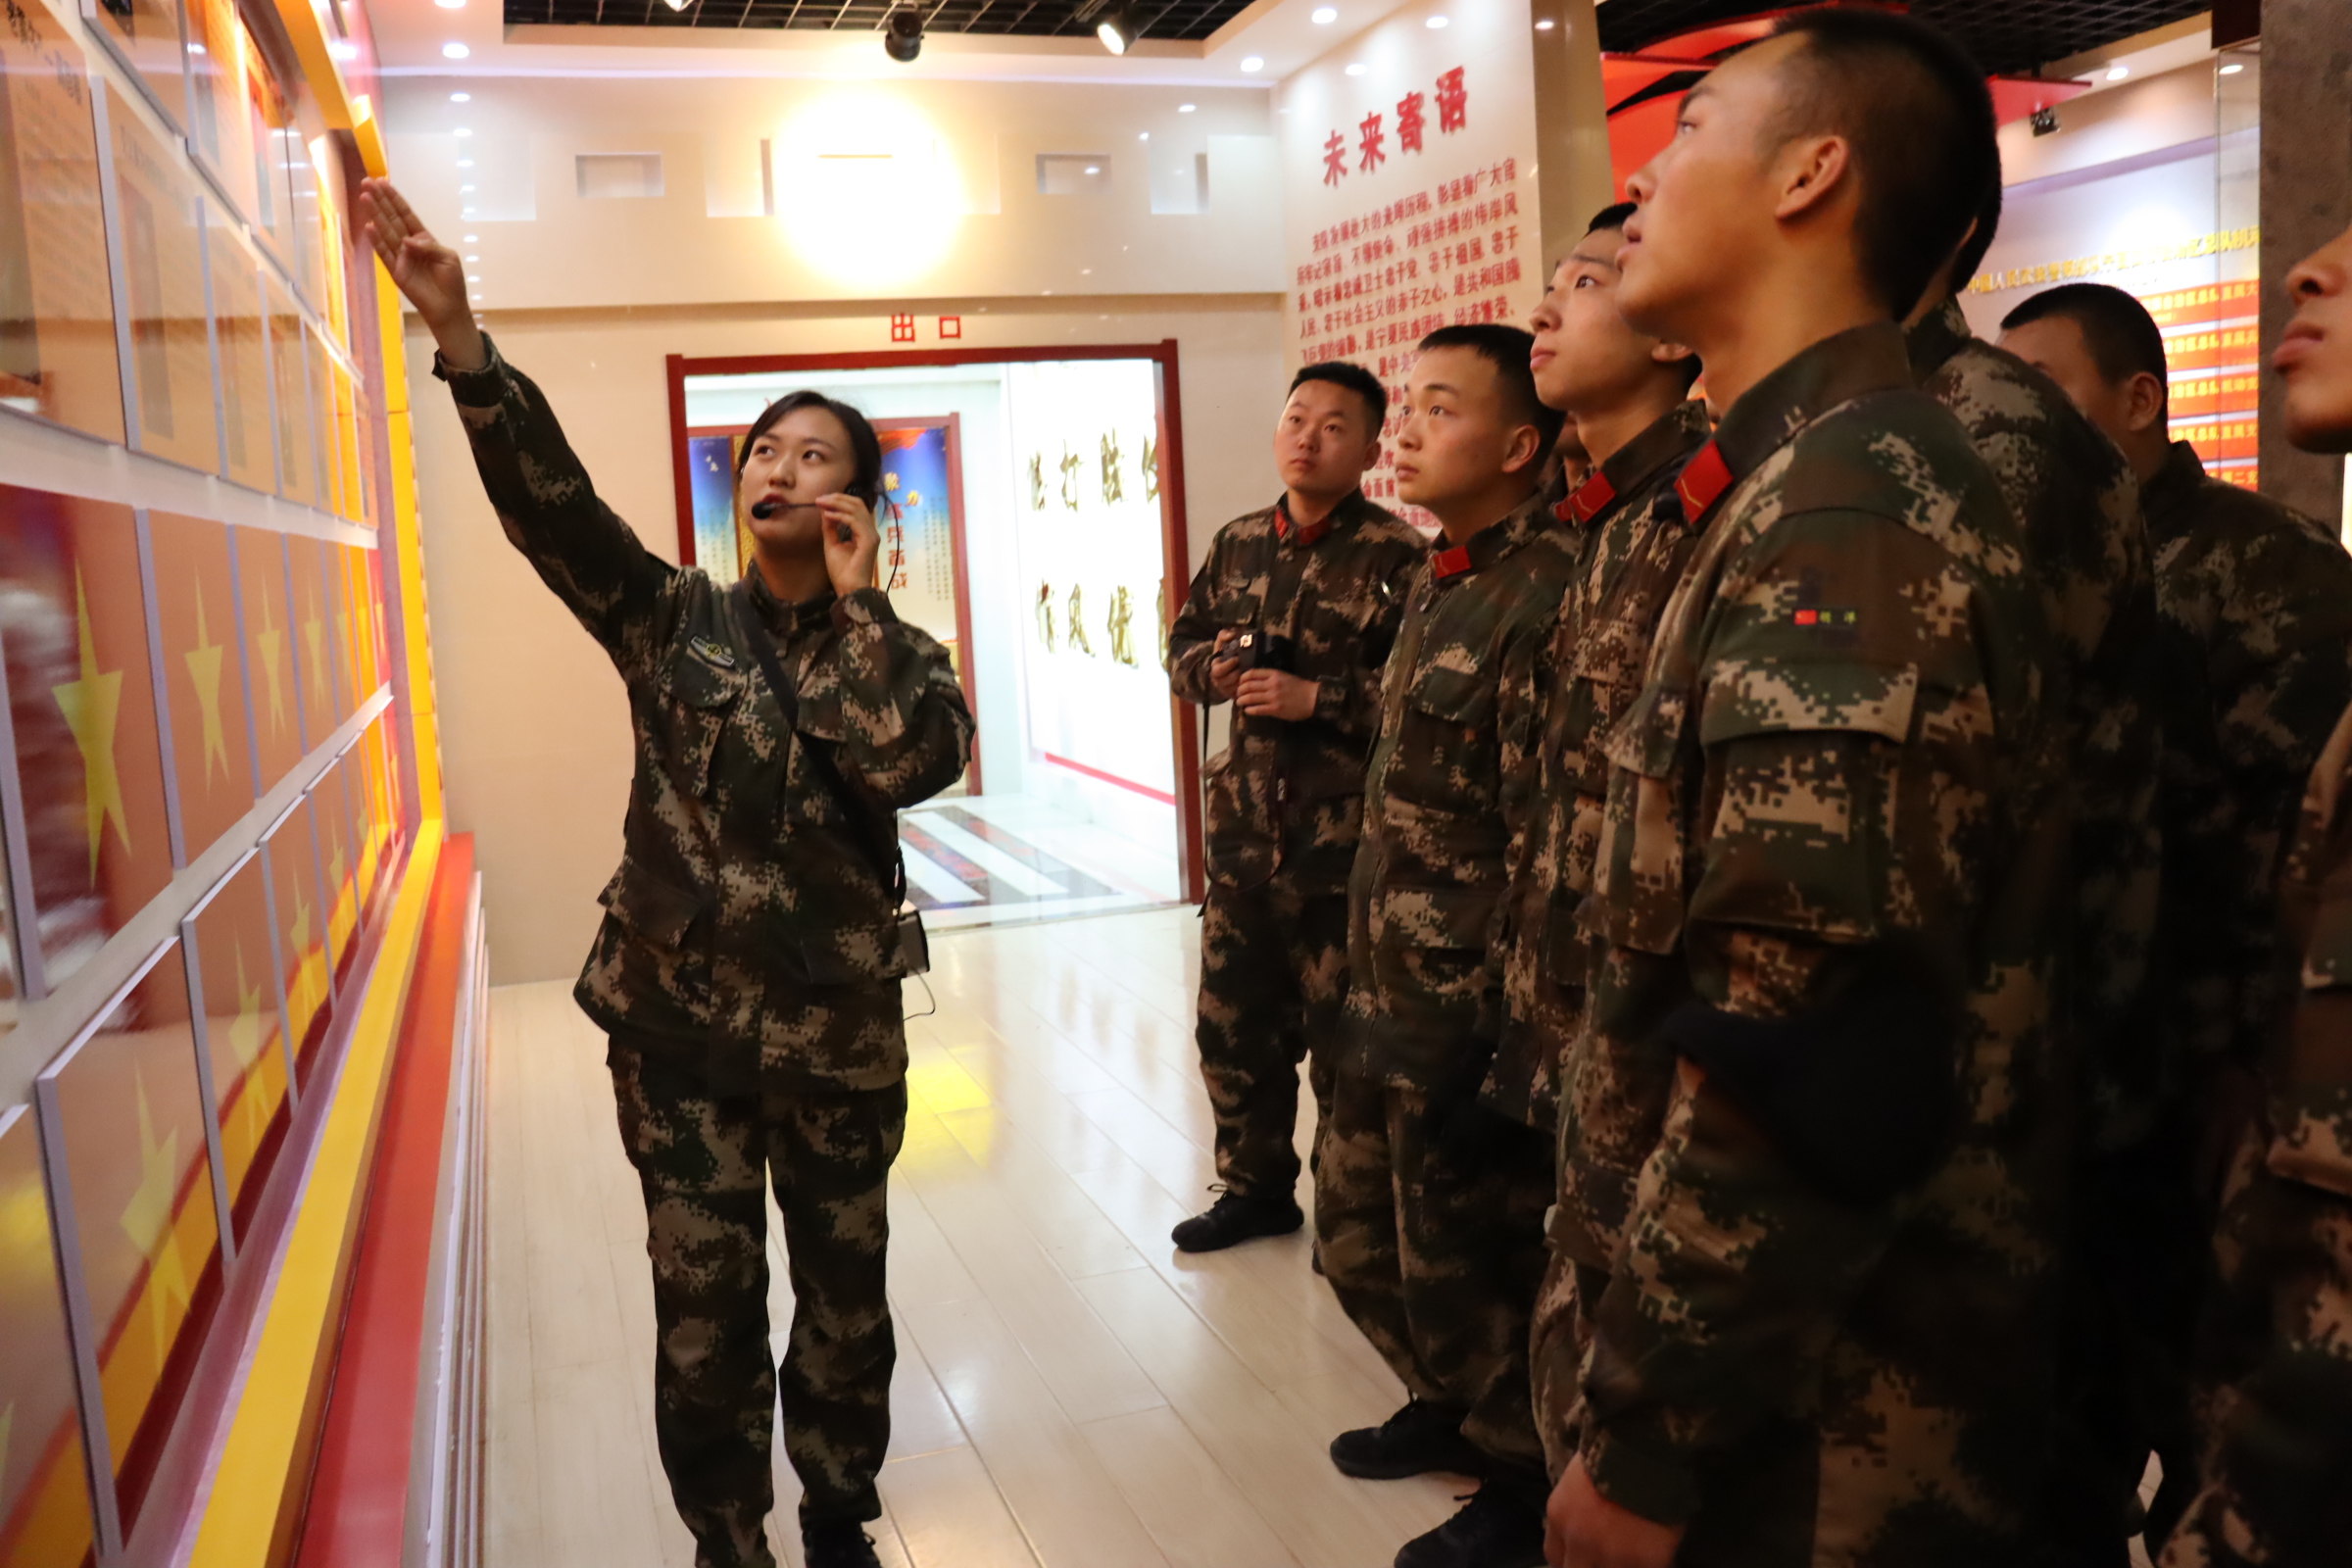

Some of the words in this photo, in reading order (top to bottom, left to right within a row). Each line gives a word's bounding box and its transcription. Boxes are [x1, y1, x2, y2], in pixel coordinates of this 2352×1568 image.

[1323, 66, 1468, 186] 未来寄语
[891, 313, 961, 343] 出口
